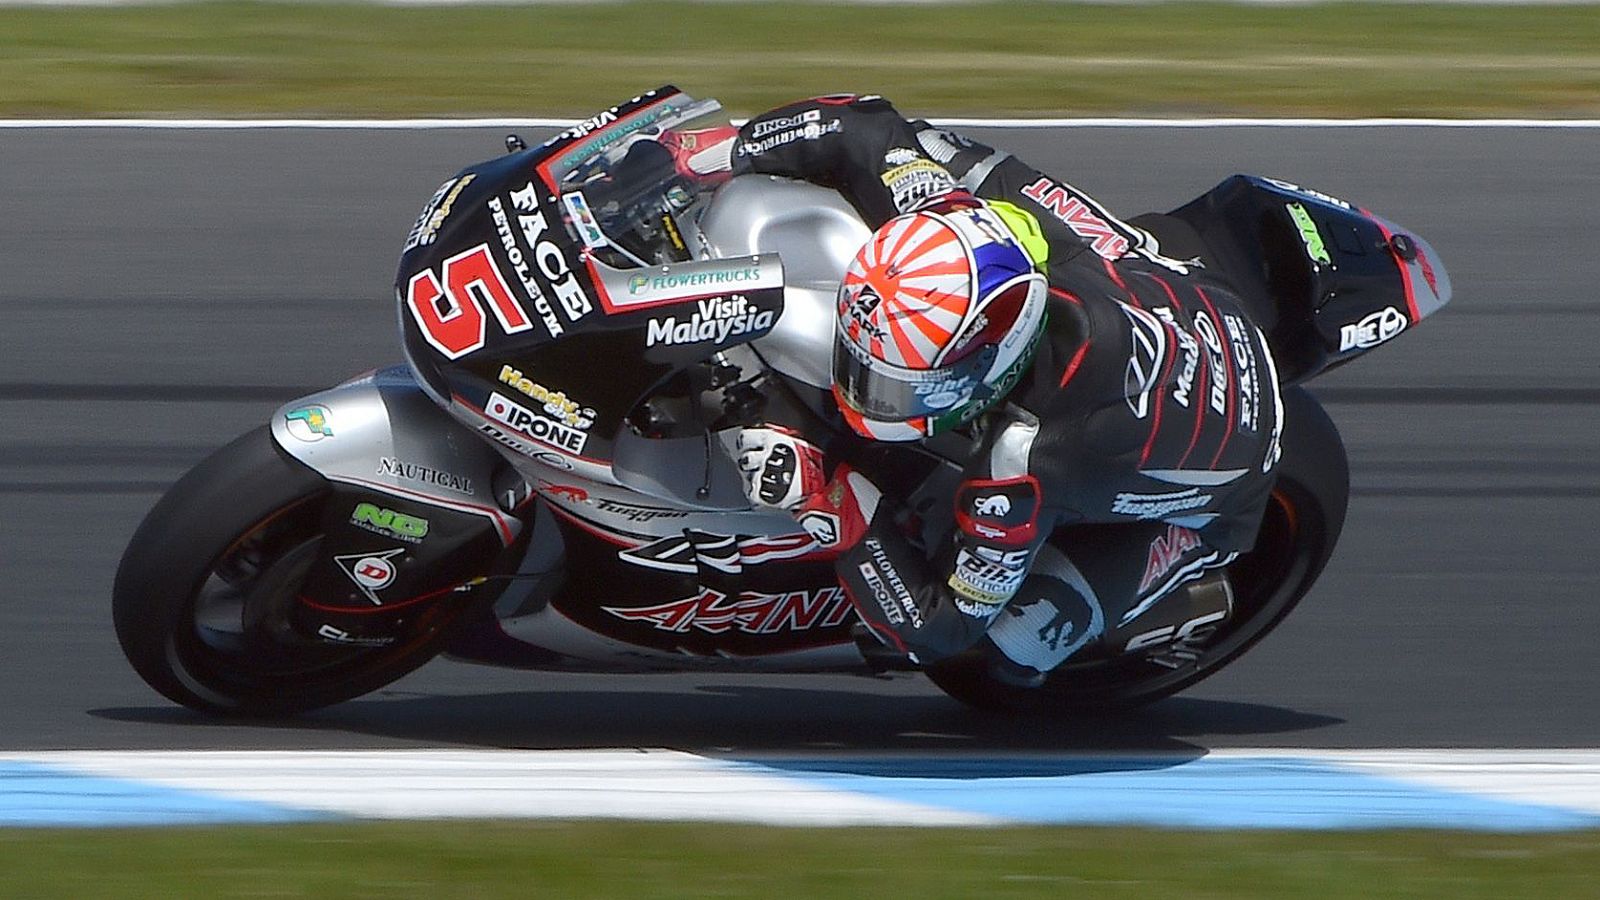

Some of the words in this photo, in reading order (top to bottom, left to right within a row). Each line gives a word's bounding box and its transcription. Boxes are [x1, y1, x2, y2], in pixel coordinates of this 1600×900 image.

[487, 196, 566, 339] PETROLEUM
[509, 181, 594, 323] FACE
[652, 268, 760, 290] FLOWERTRUCKS
[407, 242, 534, 361] 5
[697, 294, 749, 321] Visit
[646, 305, 775, 347] Malaysia
[498, 364, 580, 413] Handy
[507, 407, 584, 451] IPONE
[376, 456, 475, 496] NAUTICAL
